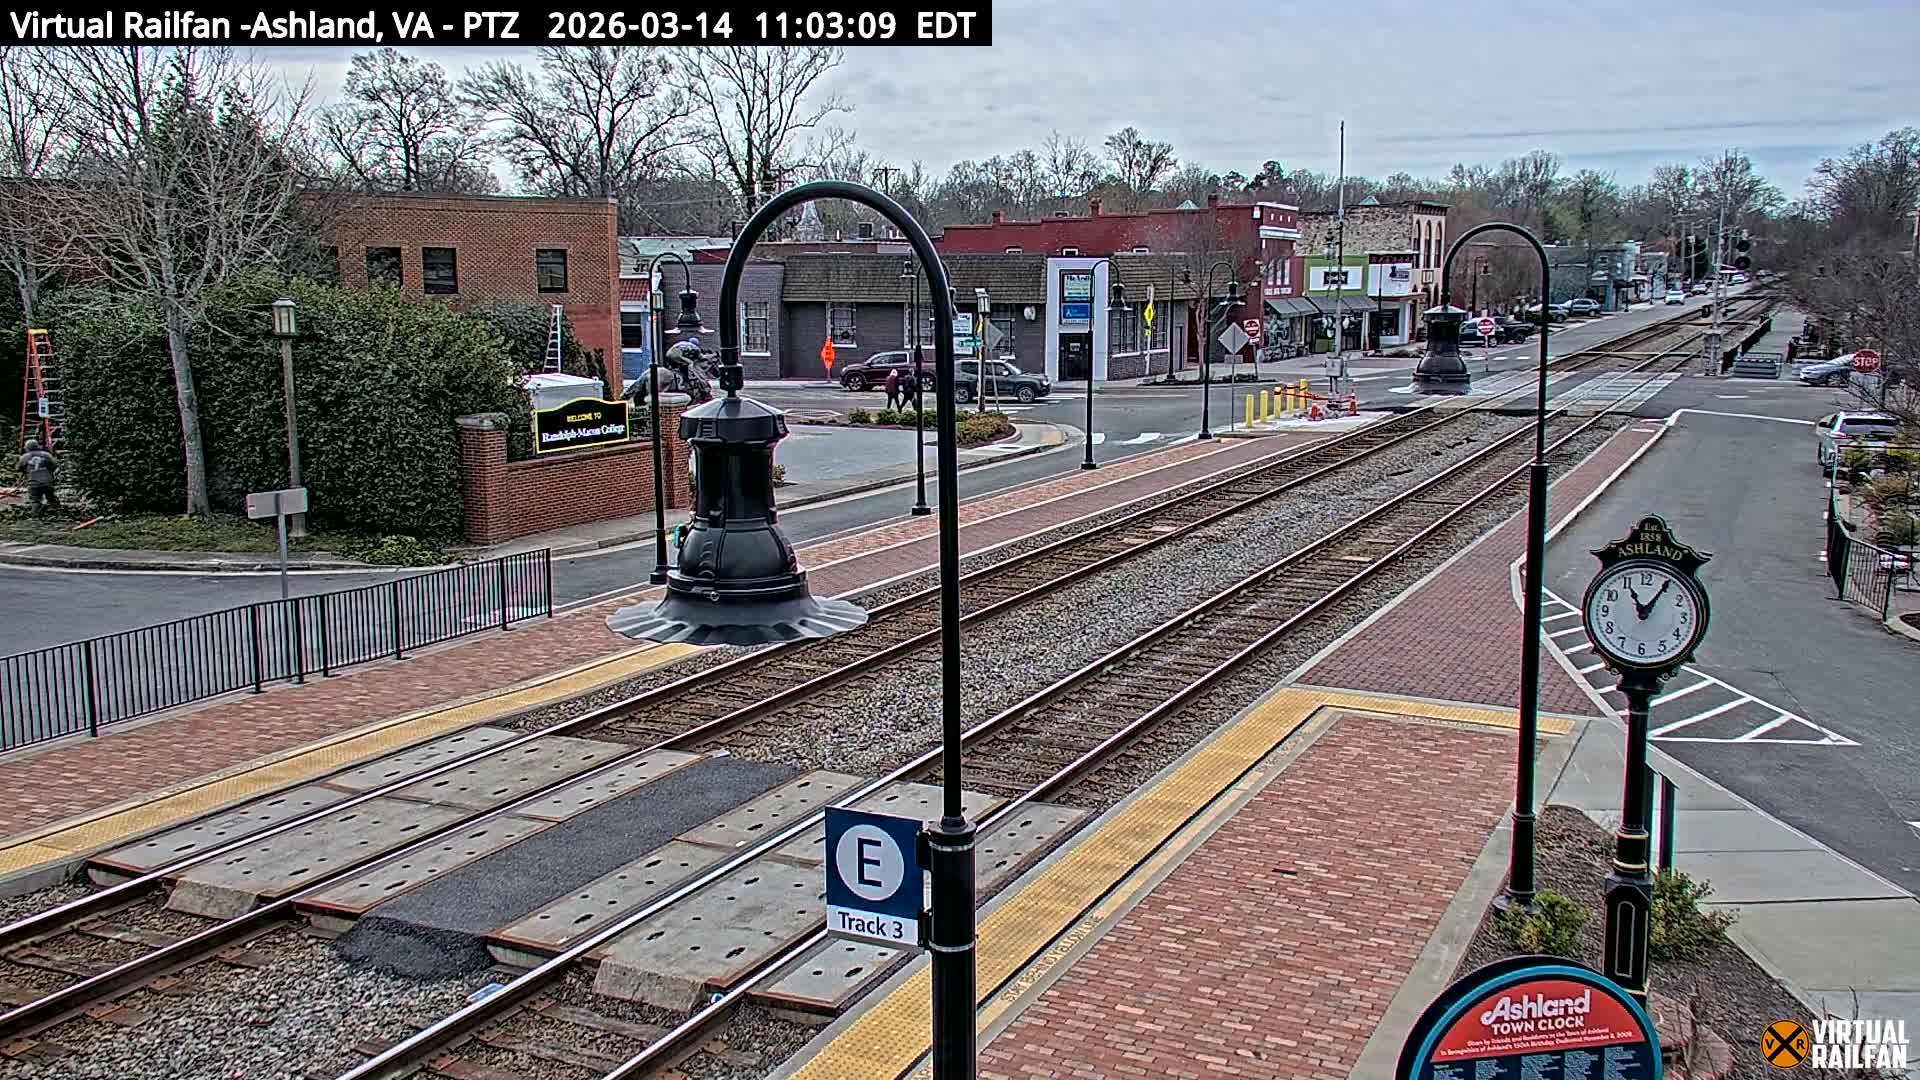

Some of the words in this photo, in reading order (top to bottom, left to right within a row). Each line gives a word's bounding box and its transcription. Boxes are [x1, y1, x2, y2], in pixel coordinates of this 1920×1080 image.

[1854, 357, 1878, 367] STOP
[1640, 532, 1663, 542] 1858
[1618, 543, 1683, 561] ASHLAND
[1623, 577, 1632, 589] 11
[1640, 574, 1653, 586] 12
[1606, 589, 1619, 602] 10
[1675, 595, 1684, 607] 2
[1601, 605, 1609, 617] 9
[1680, 613, 1688, 624] 3
[1605, 622, 1614, 634] 8
[1673, 628, 1681, 641] 4
[1617, 637, 1626, 649] 7
[1638, 642, 1646, 655] 6
[1658, 640, 1667, 653] 5
[856, 837, 883, 887] E
[838, 911, 887, 937] Track
[892, 921, 904, 939] 3
[1480, 989, 1591, 1025] Ashland
[1492, 1020, 1535, 1035] TOWN
[1538, 1016, 1585, 1031] CLOCK
